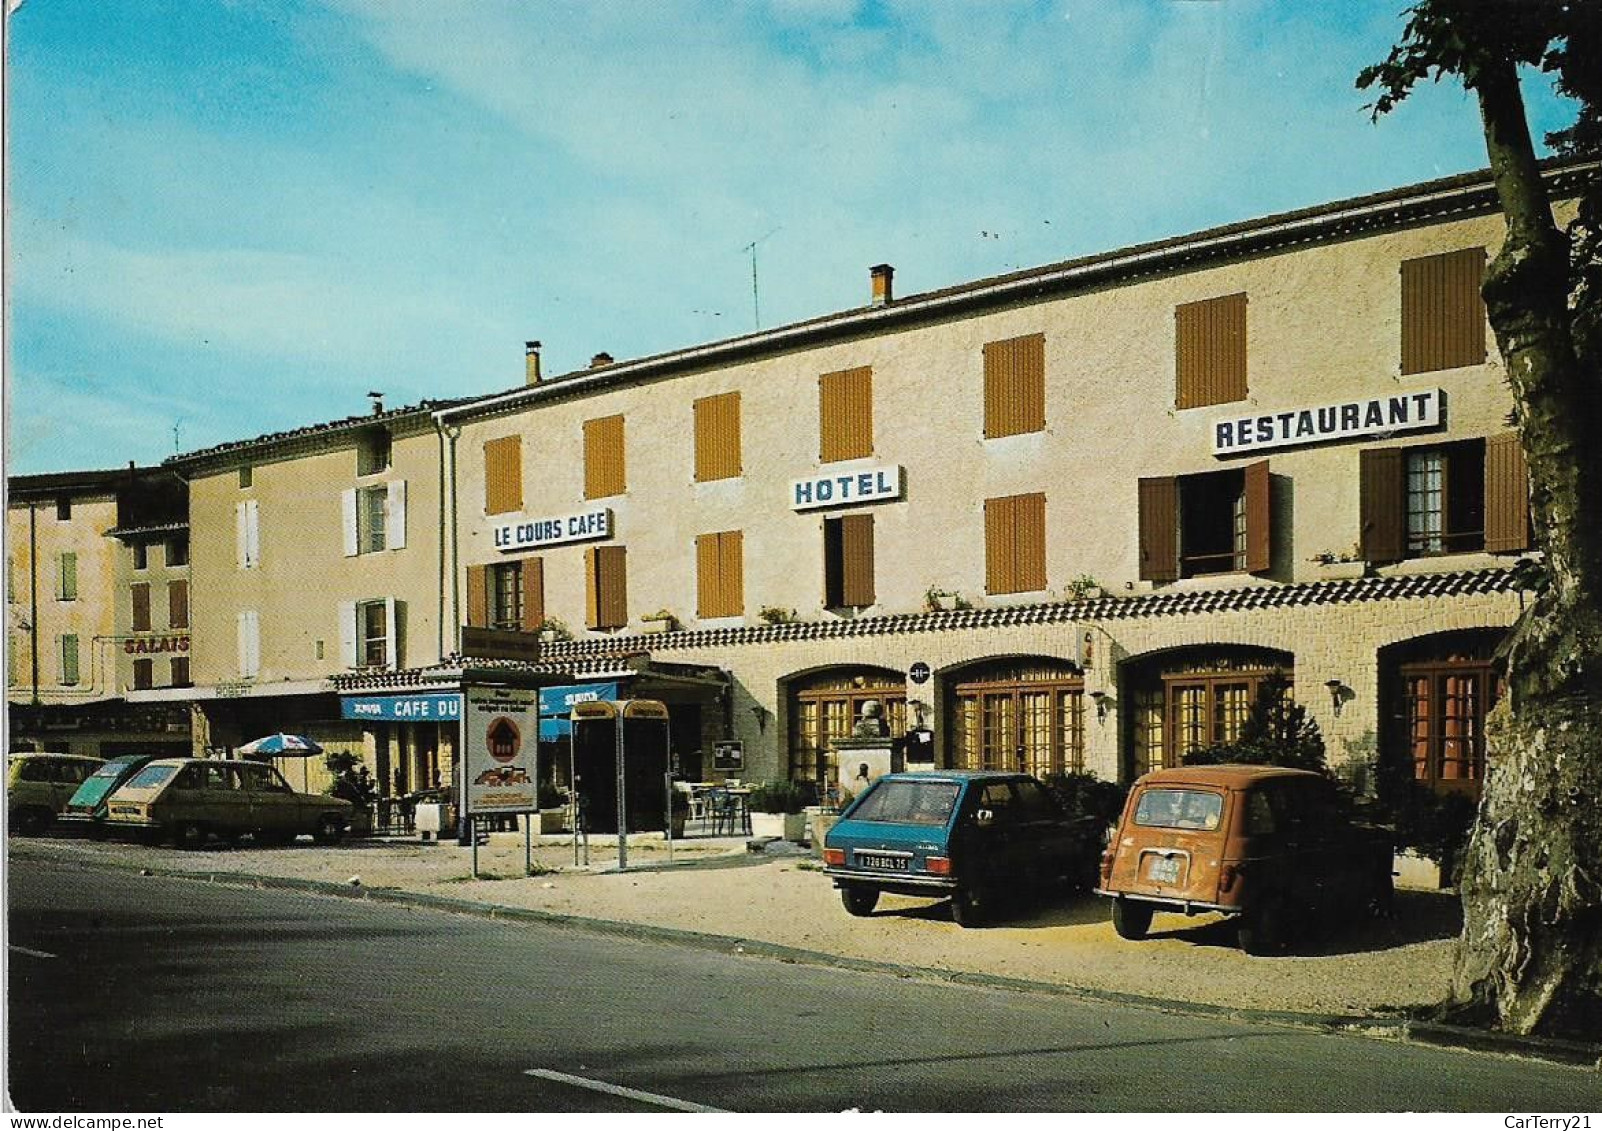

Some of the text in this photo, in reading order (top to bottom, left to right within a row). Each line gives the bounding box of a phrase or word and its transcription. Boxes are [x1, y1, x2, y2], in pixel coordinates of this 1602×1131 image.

[1216, 392, 1432, 448] RESTAURANT
[795, 471, 893, 505] HOTEL
[494, 512, 605, 546] LE COURS CAFE
[394, 700, 429, 717] CAFE
[438, 700, 458, 716] DU
